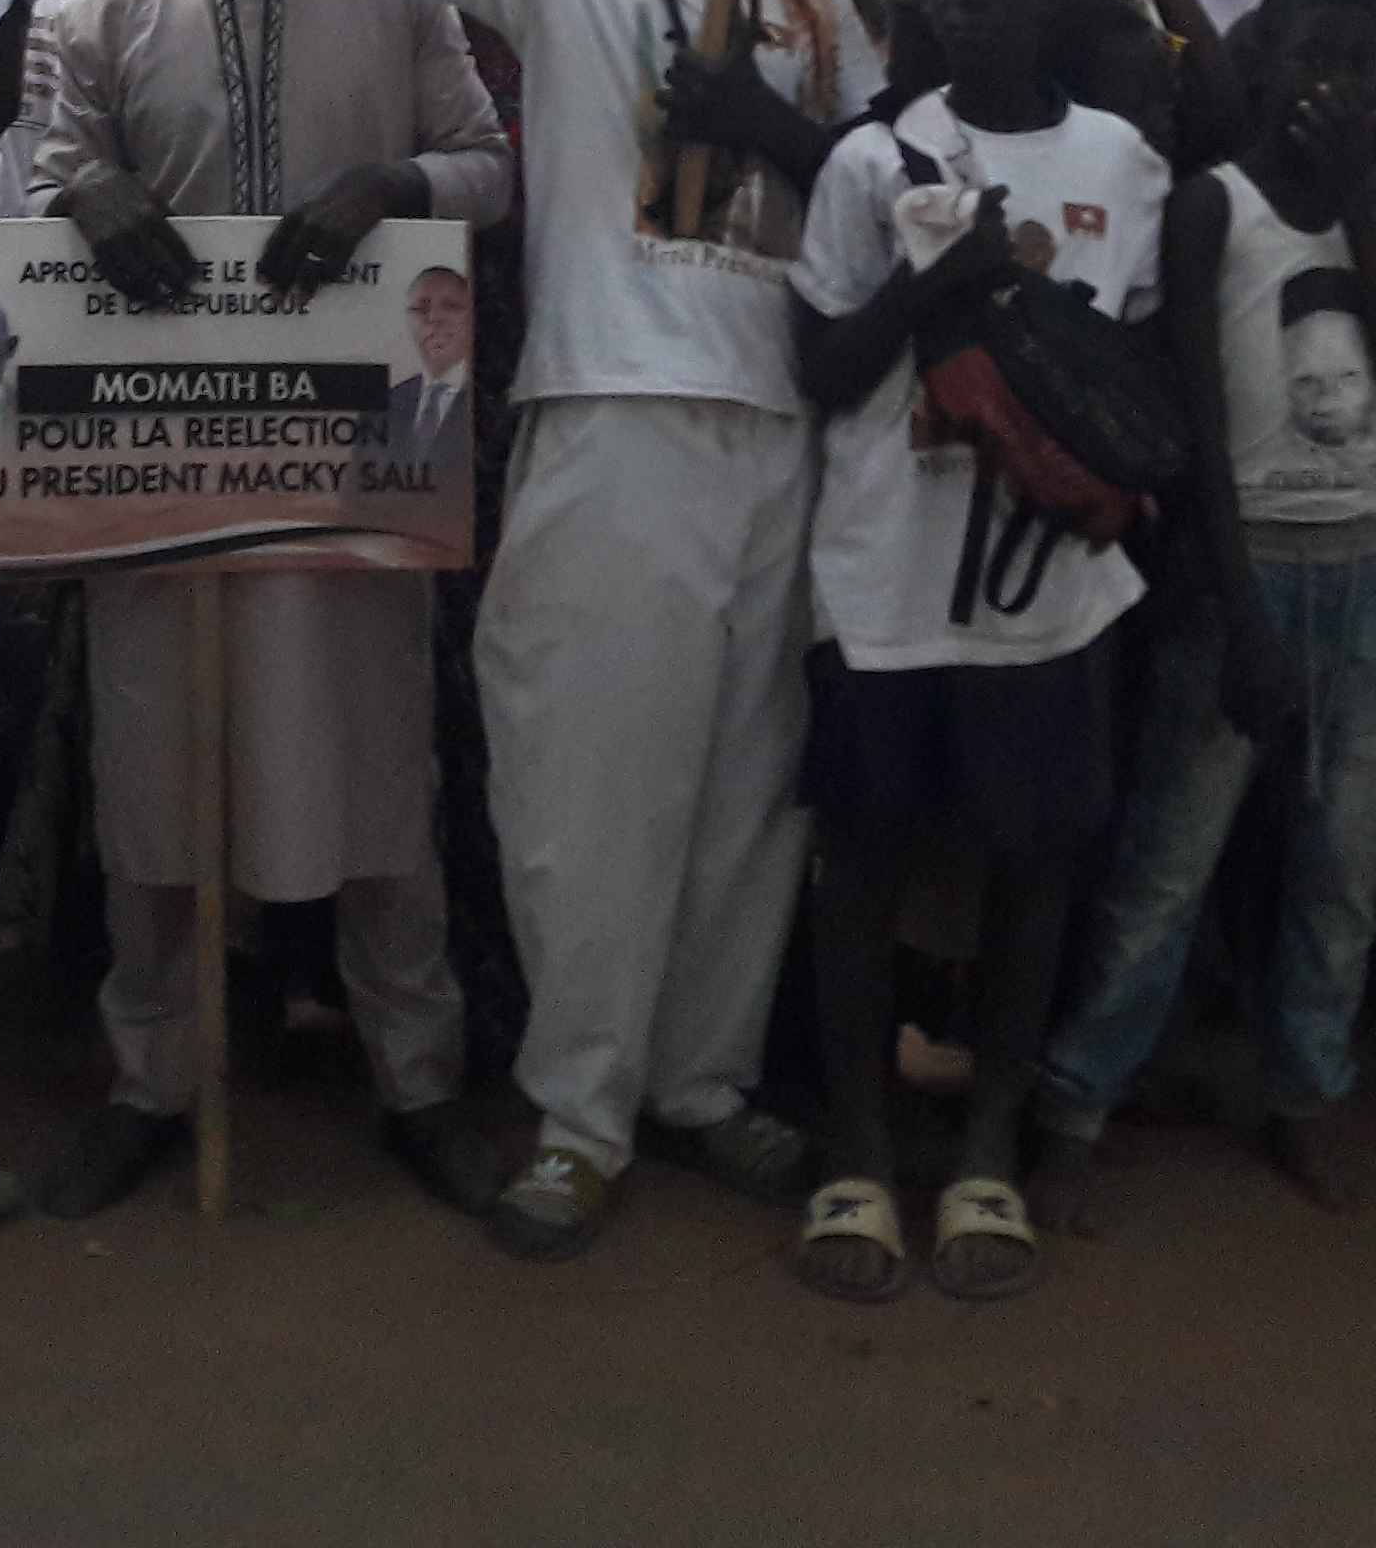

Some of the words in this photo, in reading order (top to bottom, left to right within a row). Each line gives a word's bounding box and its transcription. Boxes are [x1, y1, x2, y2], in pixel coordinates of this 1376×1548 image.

[18, 260, 108, 284] APROS
[225, 260, 246, 283] LE
[87, 293, 117, 315] DE
[90, 370, 259, 404] MOMATH
[269, 369, 318, 402] BA
[18, 417, 117, 451] POUR
[131, 417, 171, 448] LA
[184, 415, 389, 449] REELECTION
[19, 461, 208, 499] PRESIDENT
[217, 461, 351, 495] MACKY
[360, 461, 437, 494] SALL
